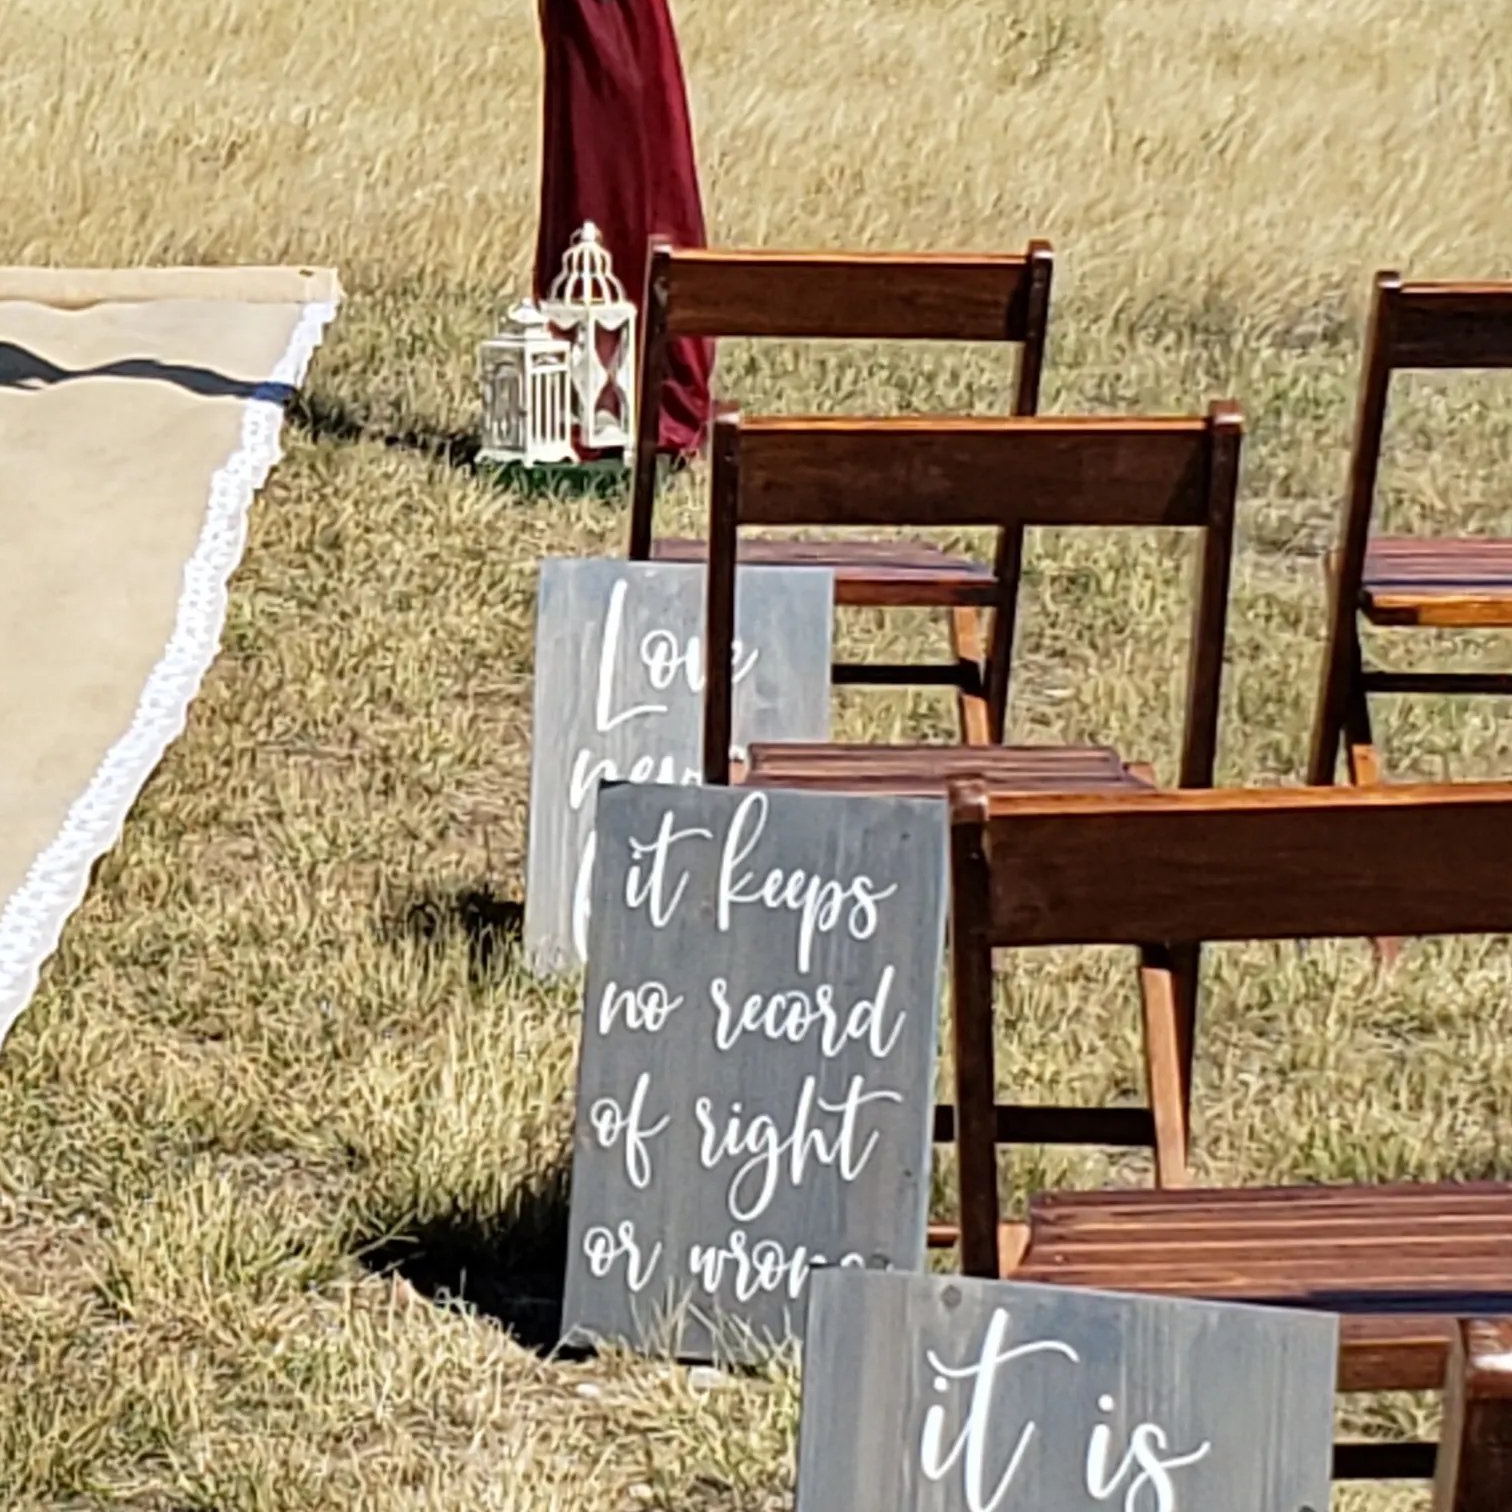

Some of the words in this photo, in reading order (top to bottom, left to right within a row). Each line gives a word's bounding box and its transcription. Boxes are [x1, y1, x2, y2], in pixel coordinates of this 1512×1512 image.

[626, 811, 713, 927] it
[719, 791, 898, 972] keeps
[599, 981, 683, 1035] no
[710, 965, 906, 1057] record
[591, 1072, 670, 1189] of
[695, 1075, 903, 1221] right
[584, 1221, 661, 1292] or
[690, 1230, 895, 1301] wron
[921, 1308, 1080, 1512] it
[1086, 1394, 1210, 1512] is
